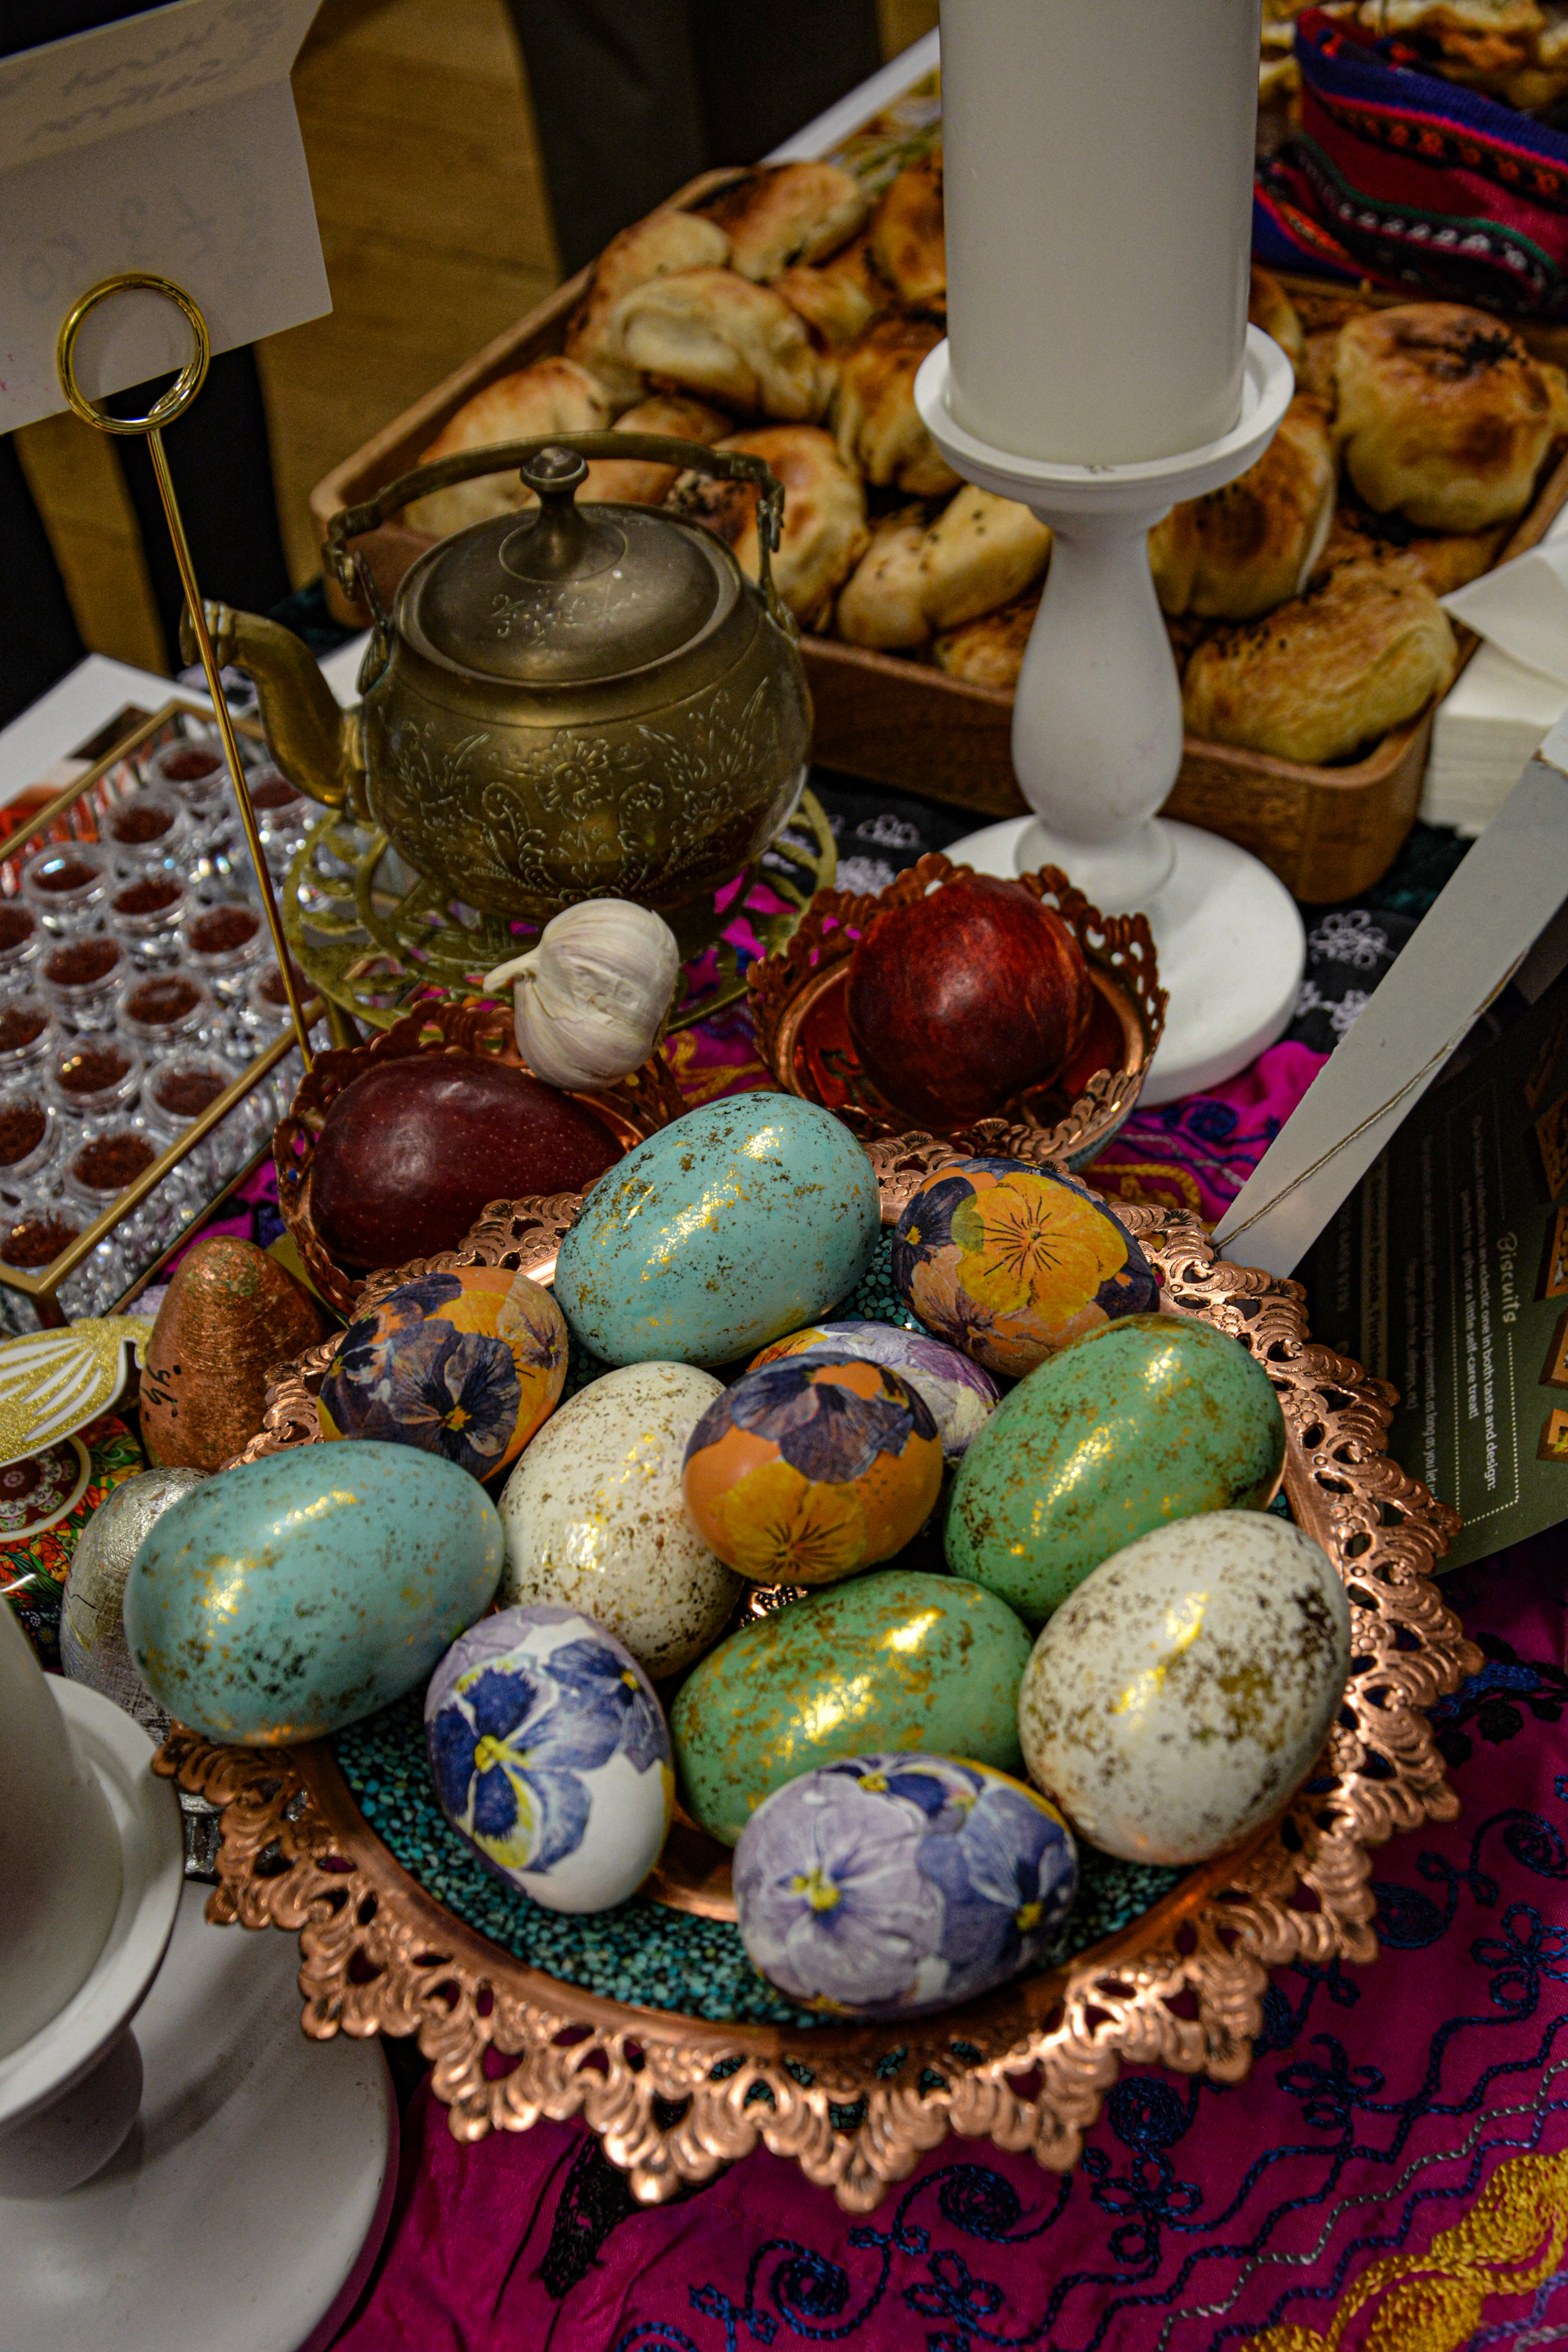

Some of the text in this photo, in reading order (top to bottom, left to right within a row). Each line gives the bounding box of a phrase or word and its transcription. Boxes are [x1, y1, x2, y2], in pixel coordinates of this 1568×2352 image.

[1497, 1231, 1520, 1324] Biscuits
[1482, 1310, 1490, 1334] one
[1482, 1334, 1493, 1348] in
[1466, 1331, 1478, 1383] self-care
[1482, 1348, 1494, 1381] both
[1426, 1401, 1435, 1413] as
[1468, 1383, 1480, 1420] treat!
[1484, 1381, 1495, 1414] taste
[1421, 1412, 1438, 1437] long
[1485, 1416, 1497, 1441] and
[1425, 1437, 1435, 1449] as
[1423, 1448, 1435, 1468] you
[1484, 1442, 1498, 1490] design:
[1425, 1468, 1439, 1483] let
